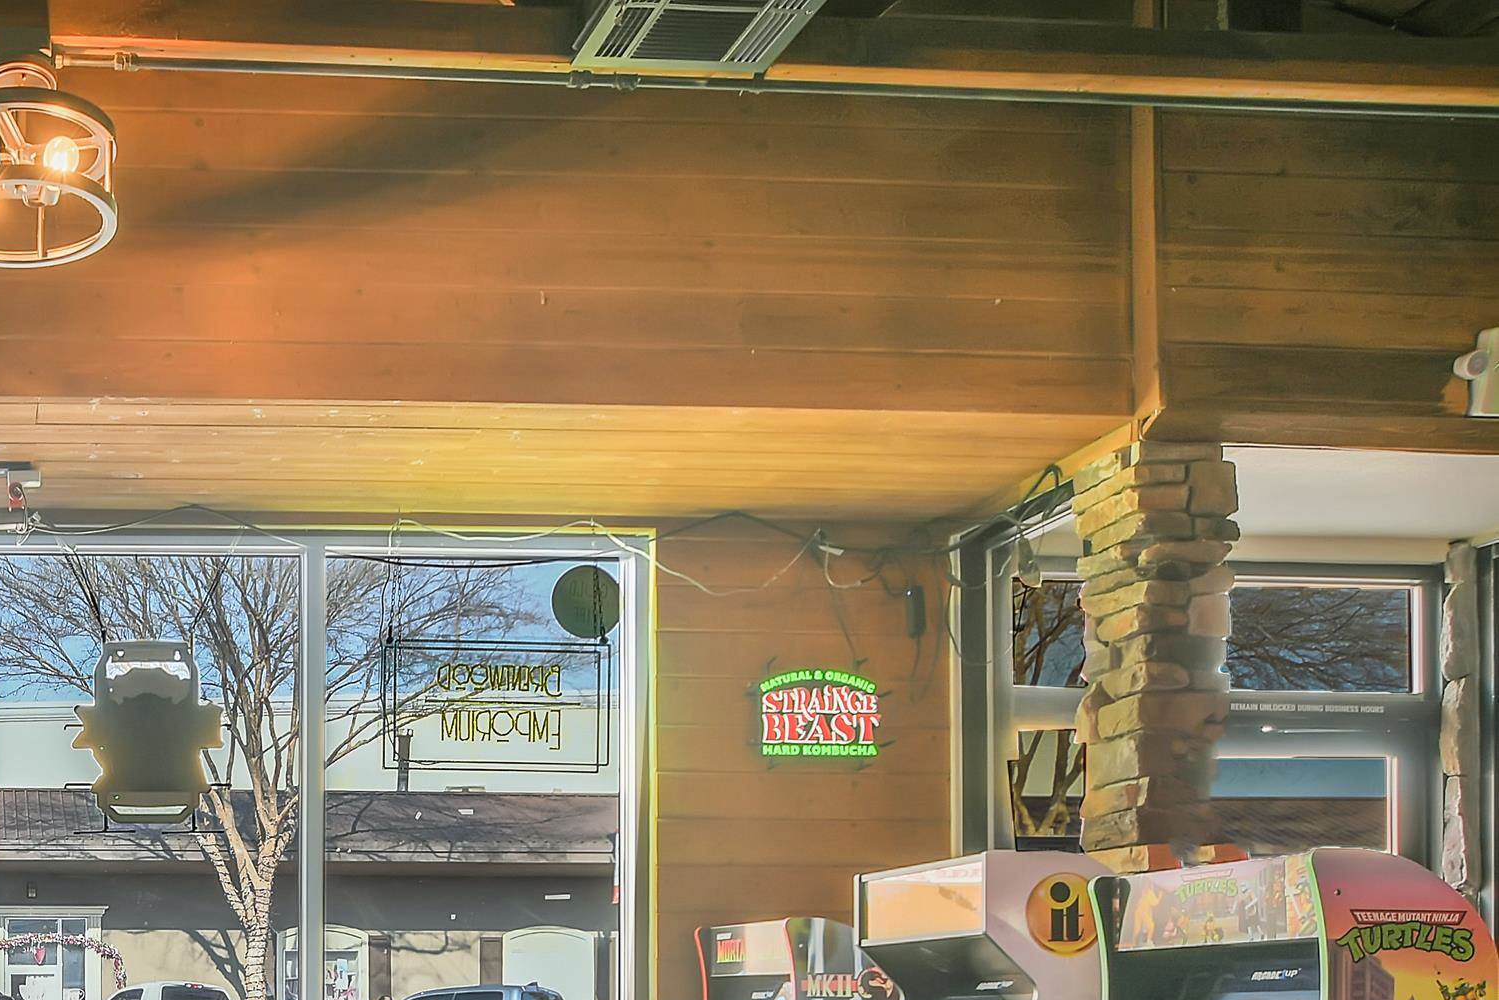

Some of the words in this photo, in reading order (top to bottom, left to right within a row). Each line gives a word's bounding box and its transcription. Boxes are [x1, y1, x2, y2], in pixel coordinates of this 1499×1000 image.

[760, 671, 812, 691] NATURAL
[814, 670, 823, 680] &
[825, 671, 876, 694] ORGANIC
[1230, 703, 1259, 711] REMAIN
[1259, 704, 1295, 712] UNLOCKED
[763, 713, 881, 744] BEAST
[763, 745, 800, 755] HARD
[803, 745, 878, 755] KOMBUCHA
[1354, 912, 1397, 922] TEENAGE
[1397, 912, 1431, 922] MUTANT
[1432, 913, 1460, 922] NINJA
[1336, 921, 1475, 962] TURTLES
